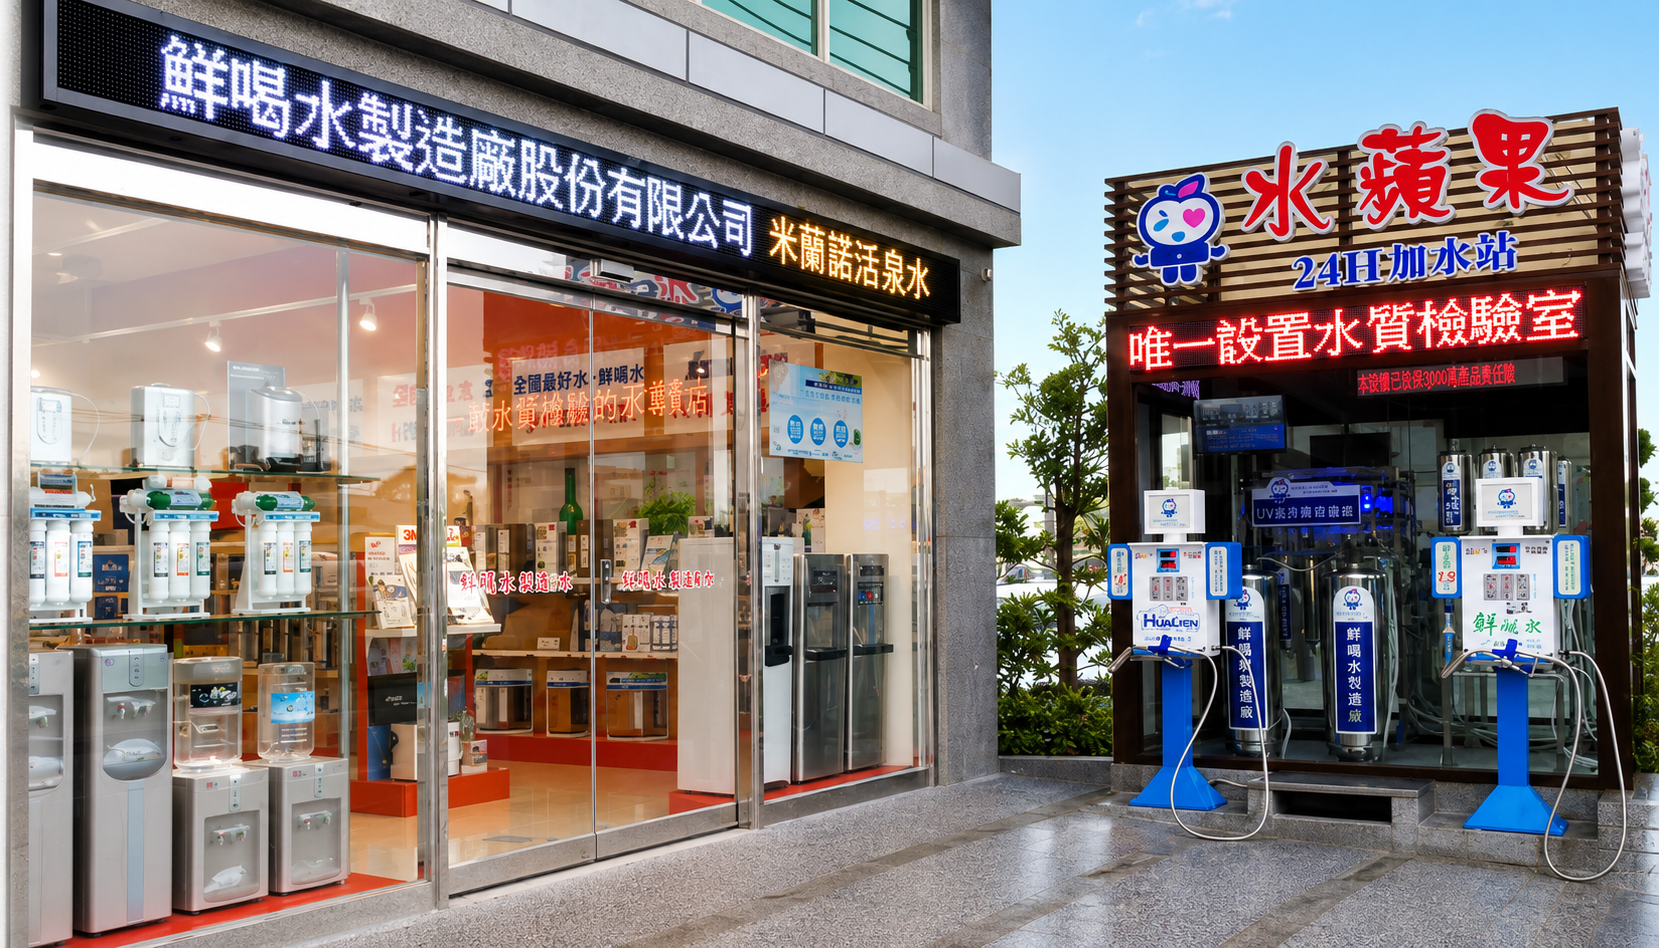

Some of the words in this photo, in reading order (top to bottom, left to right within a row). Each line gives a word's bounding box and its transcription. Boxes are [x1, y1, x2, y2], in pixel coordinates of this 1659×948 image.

[160, 34, 754, 257] 鮮喝水製造廠股份有限公司
[1242, 111, 1573, 240] 水蘋果
[768, 215, 931, 300] 米蘭諾活泉水
[1293, 231, 1518, 290] 24H加水站
[1128, 289, 1584, 371] 唯一設置水質檢驗室
